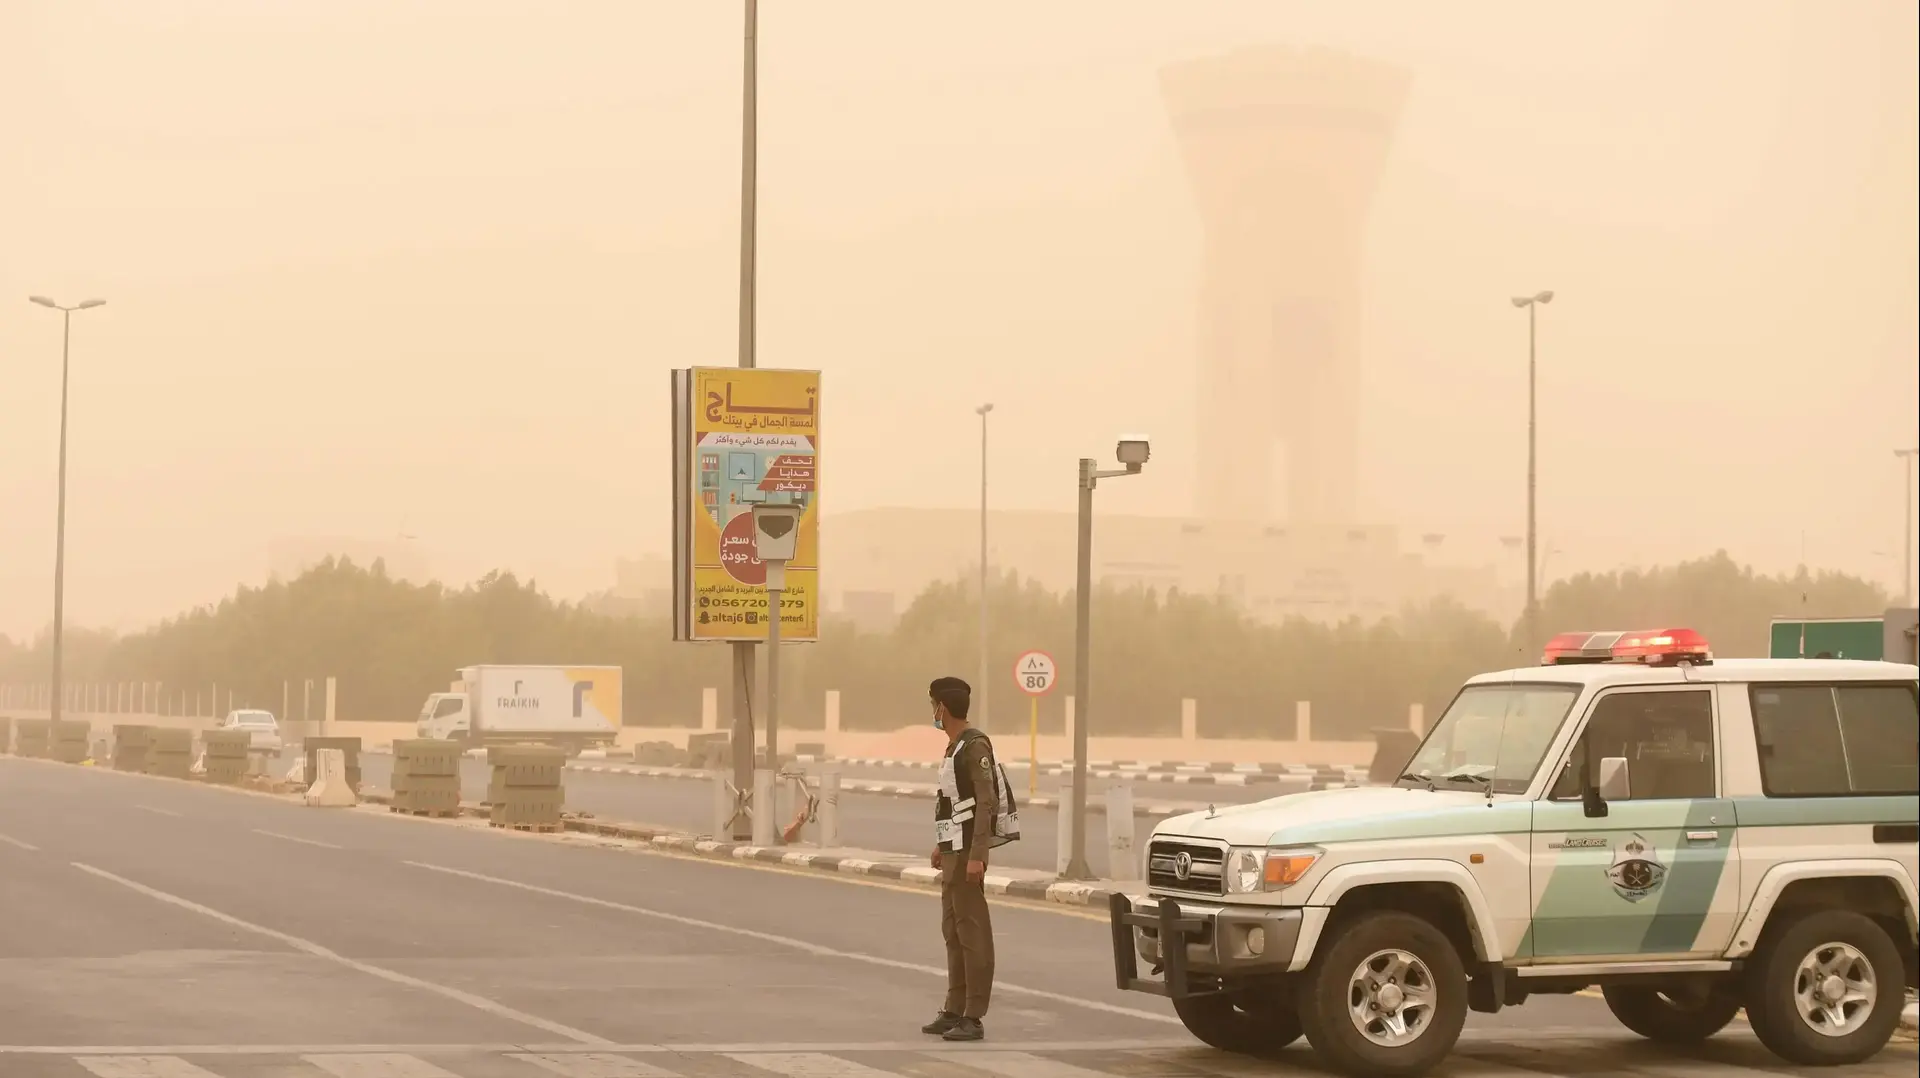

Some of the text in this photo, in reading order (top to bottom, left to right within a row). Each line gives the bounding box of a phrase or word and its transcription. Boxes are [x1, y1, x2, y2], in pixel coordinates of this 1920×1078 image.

[706, 382, 816, 422] تاج
[722, 414, 813, 432] لمسة الجمال في بيتك
[735, 436, 752, 447] شيء
[753, 437, 764, 446] كل
[766, 437, 779, 446] لكم
[781, 438, 797, 447] يقدم
[782, 456, 813, 466] تحف
[779, 467, 810, 479] هدايا
[775, 481, 807, 491] ديكور
[722, 536, 750, 548] سعر
[721, 549, 749, 564] جودة
[711, 598, 804, 608] 056720979
[712, 612, 743, 624] altaj6
[1028, 657, 1044, 669] ٨٠
[1026, 676, 1046, 689] 80
[497, 697, 540, 709] FRAIKIN
